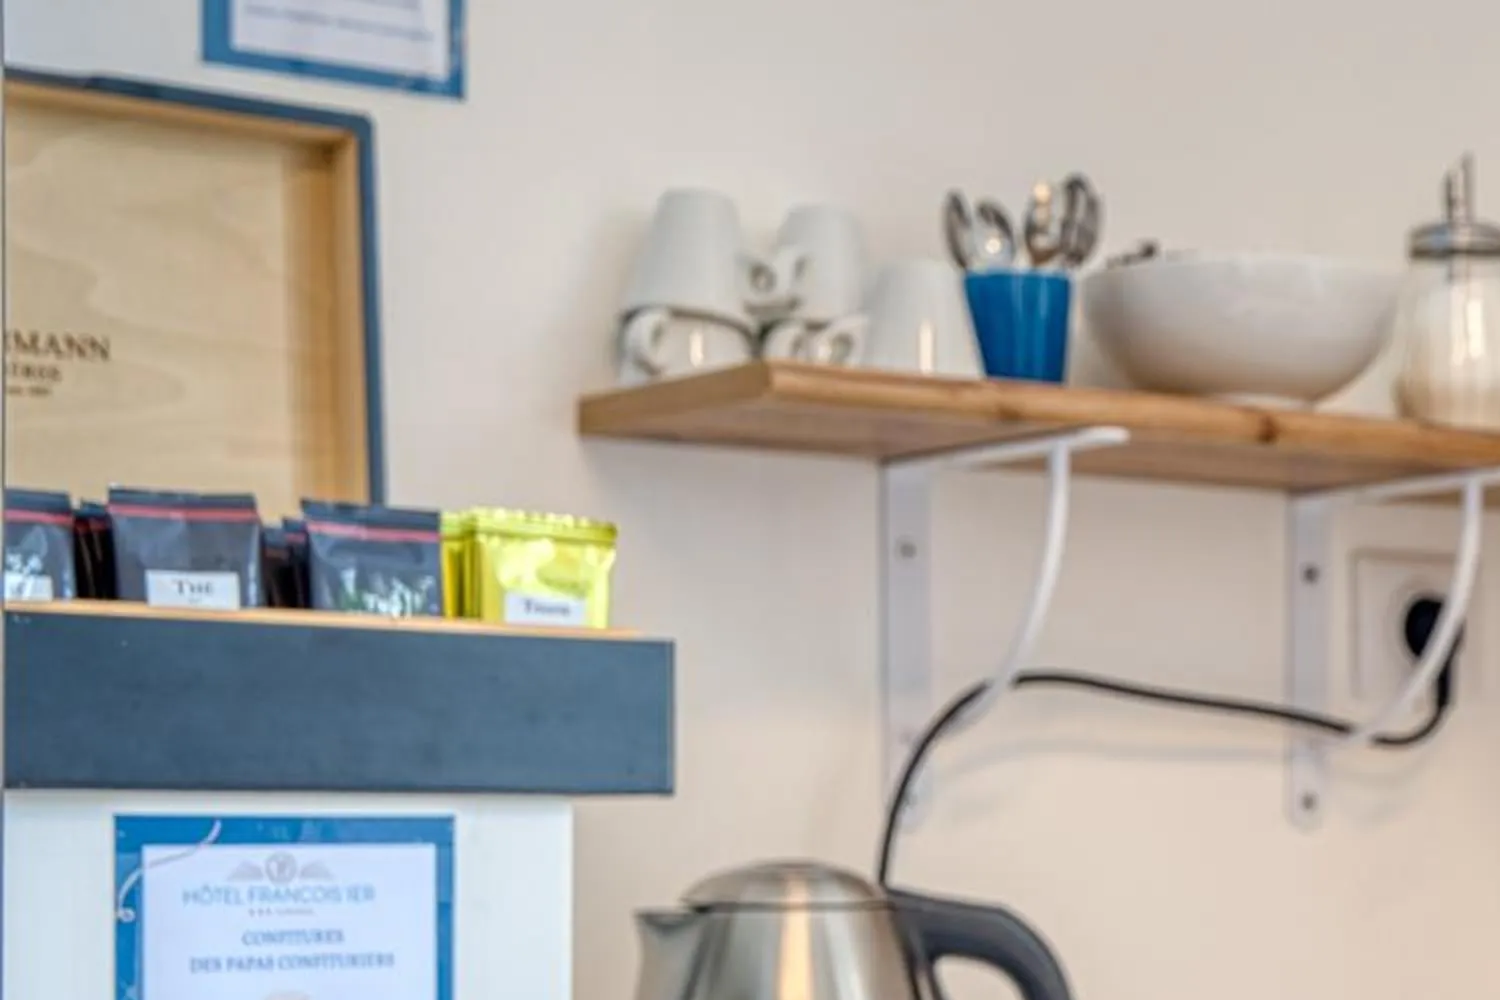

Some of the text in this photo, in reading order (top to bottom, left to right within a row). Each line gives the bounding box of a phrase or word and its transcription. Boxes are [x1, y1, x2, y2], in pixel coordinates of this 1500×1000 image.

[182, 885, 243, 906] HÔTEL
[241, 929, 345, 946] CONFITURES
[226, 956, 274, 972] PAPAS
